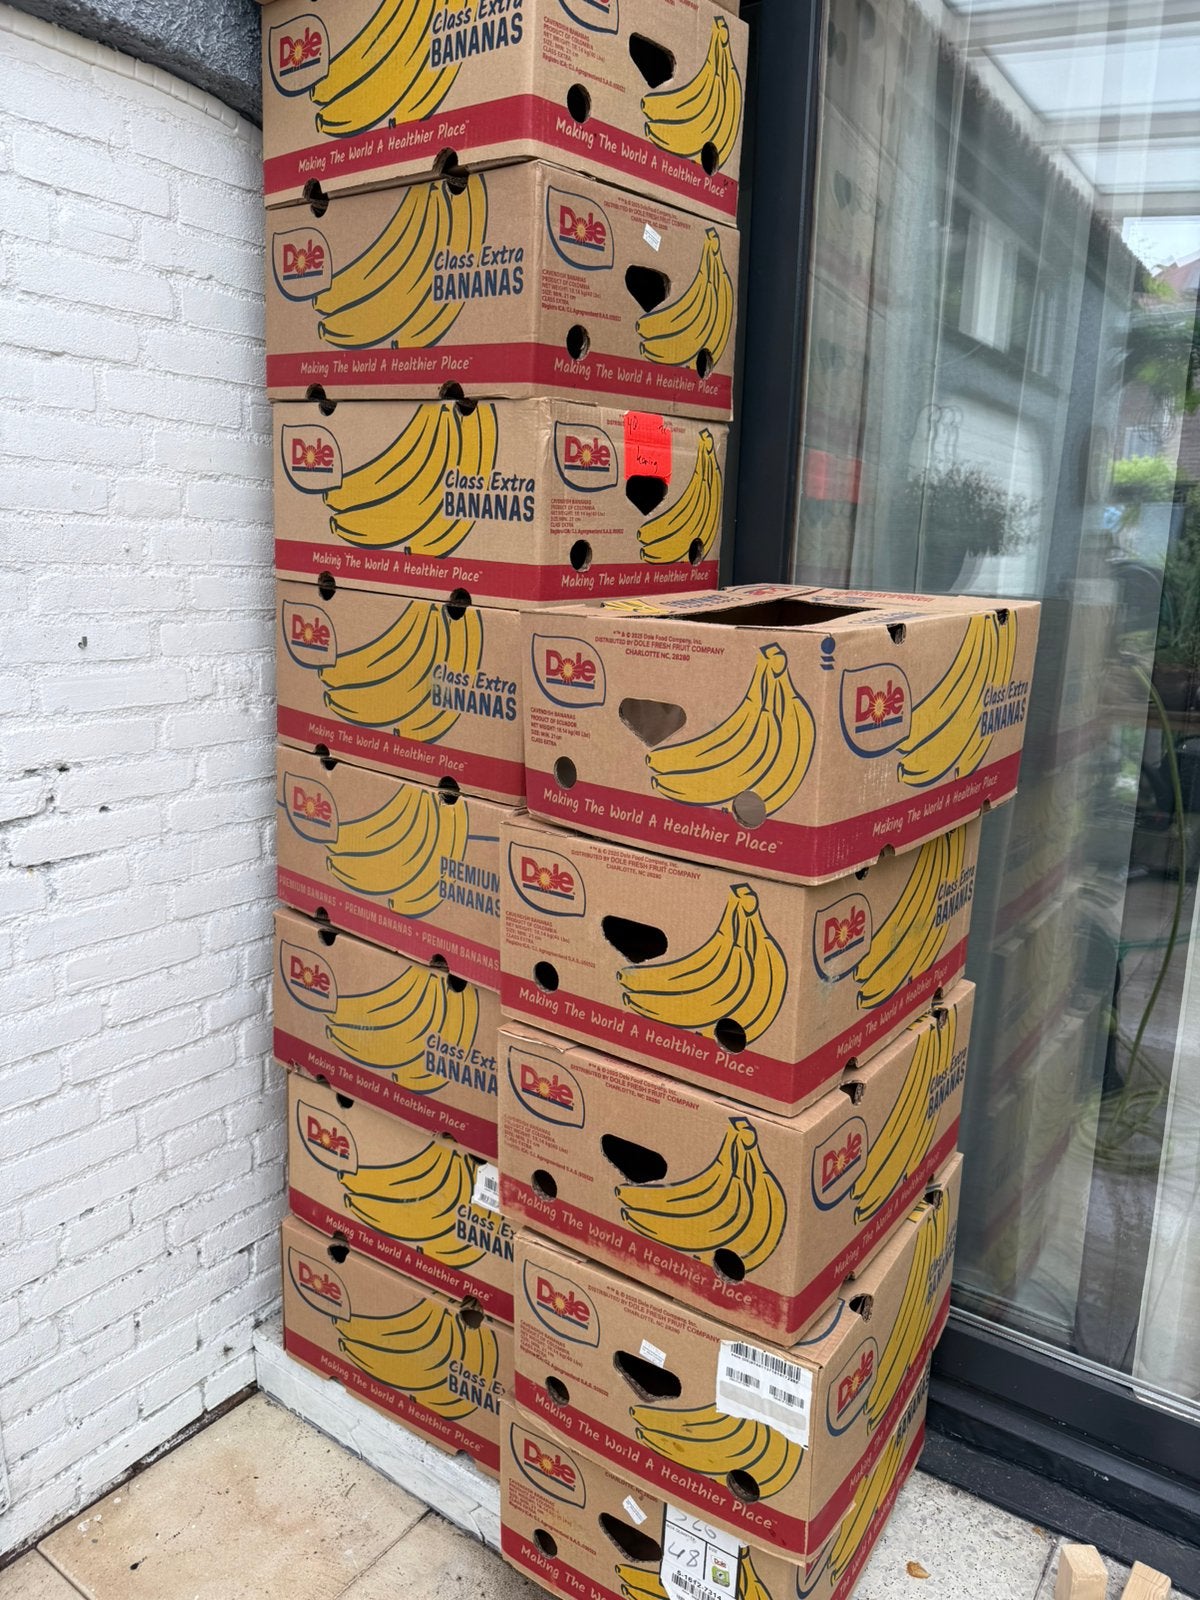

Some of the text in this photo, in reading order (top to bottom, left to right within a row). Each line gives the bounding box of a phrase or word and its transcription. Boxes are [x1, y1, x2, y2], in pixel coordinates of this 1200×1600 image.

[432, 8, 472, 34] Class
[280, 27, 321, 68] Dole
[431, 12, 523, 67] BANANAS
[298, 155, 326, 173] Making
[330, 150, 345, 165] The
[349, 142, 372, 160] World
[378, 141, 383, 152] A
[388, 130, 433, 151] Healthier
[556, 117, 594, 148] Making
[599, 133, 617, 154] The
[621, 144, 648, 165] World
[651, 155, 657, 168] A
[662, 162, 701, 189] Healthier
[559, 205, 606, 245] Dole
[283, 240, 325, 274] Dole
[434, 246, 523, 271] Class Extra
[433, 266, 524, 301] BANANAS
[301, 362, 329, 377] Making
[333, 360, 349, 373] The
[352, 359, 376, 373] World
[381, 359, 387, 370] A
[392, 356, 436, 370] Healthier
[554, 358, 591, 381] Making
[596, 364, 614, 379] The
[617, 367, 642, 384] World
[646, 372, 651, 383] A
[656, 375, 696, 391] Healthier
[292, 438, 334, 468] Dole
[565, 436, 611, 467] Dole
[445, 470, 535, 492] Class Extra
[444, 491, 535, 522] BANANAS
[312, 552, 342, 569] Making
[345, 553, 361, 568] The
[365, 558, 389, 571] World
[393, 561, 399, 572] A
[404, 562, 448, 578] Healthier
[561, 574, 595, 591] Making
[599, 573, 614, 586] The
[619, 572, 640, 584] World
[644, 572, 650, 583] A
[654, 570, 688, 583] Healthier
[292, 614, 330, 645] Dole
[545, 649, 596, 684] Dole
[626, 649, 660, 658] CHARLOTTE
[651, 642, 671, 650] FRESH
[692, 647, 724, 655] COMPANY
[432, 664, 516, 695] Class Extra
[983, 681, 1028, 707] Class Extra
[432, 684, 516, 721] BANANAS
[855, 680, 904, 725] Dole
[980, 698, 1027, 737] BANANAS
[308, 722, 335, 742] Making
[338, 730, 353, 745] The
[357, 734, 380, 751] World
[383, 740, 389, 752] A
[393, 740, 436, 764] Healthier
[293, 786, 332, 820] Dole
[543, 788, 579, 813] Making
[585, 798, 605, 816] The
[610, 805, 642, 825] World
[649, 813, 657, 827] A
[664, 817, 729, 843] Healthier
[872, 799, 944, 837] Making The World
[521, 856, 574, 892] Dole
[628, 861, 648, 869] FRESH
[649, 865, 667, 873] FRUIT
[668, 869, 701, 879] COMPANY
[278, 875, 499, 971] PREMIUM BANANAS PREMIUM BANANAS PREMIUM BANANAS
[824, 906, 866, 950] Dole
[290, 956, 330, 990] Dole
[519, 987, 559, 1015] Making
[565, 1002, 586, 1020] The
[591, 1012, 624, 1033] World
[630, 1024, 639, 1038] A
[645, 1026, 710, 1062] Healthier
[426, 1033, 464, 1059] Class
[308, 1052, 335, 1075] Making
[338, 1062, 353, 1081] The
[356, 1074, 379, 1093] World
[383, 1088, 389, 1098] A
[393, 1090, 436, 1120] Healthier
[520, 1064, 574, 1106] Dole
[308, 1115, 350, 1154] Dole
[457, 1204, 493, 1230] Class
[326, 1215, 354, 1239] Making
[359, 1228, 374, 1247] The
[377, 1240, 402, 1259] World
[406, 1252, 411, 1263] A
[416, 1256, 459, 1286] Healthier
[517, 1190, 556, 1222] Making
[562, 1209, 583, 1230] The
[588, 1222, 622, 1248] World
[628, 1242, 636, 1258] A
[643, 1246, 707, 1286] Healthier
[298, 1261, 342, 1300] Dole
[536, 1277, 590, 1322] Dole
[449, 1361, 486, 1387] Class
[321, 1355, 349, 1380] Making
[352, 1373, 368, 1392] The
[371, 1384, 394, 1404] World
[398, 1398, 404, 1410] A
[409, 1400, 451, 1435] Healthier
[524, 1439, 576, 1484] Dole
[535, 1392, 573, 1428] Making
[578, 1419, 600, 1441] The
[605, 1437, 640, 1463] World
[646, 1456, 654, 1471] A
[661, 1464, 727, 1507] Healthier
[521, 1544, 586, 1594] Making The
[668, 1542, 700, 1567] 48
